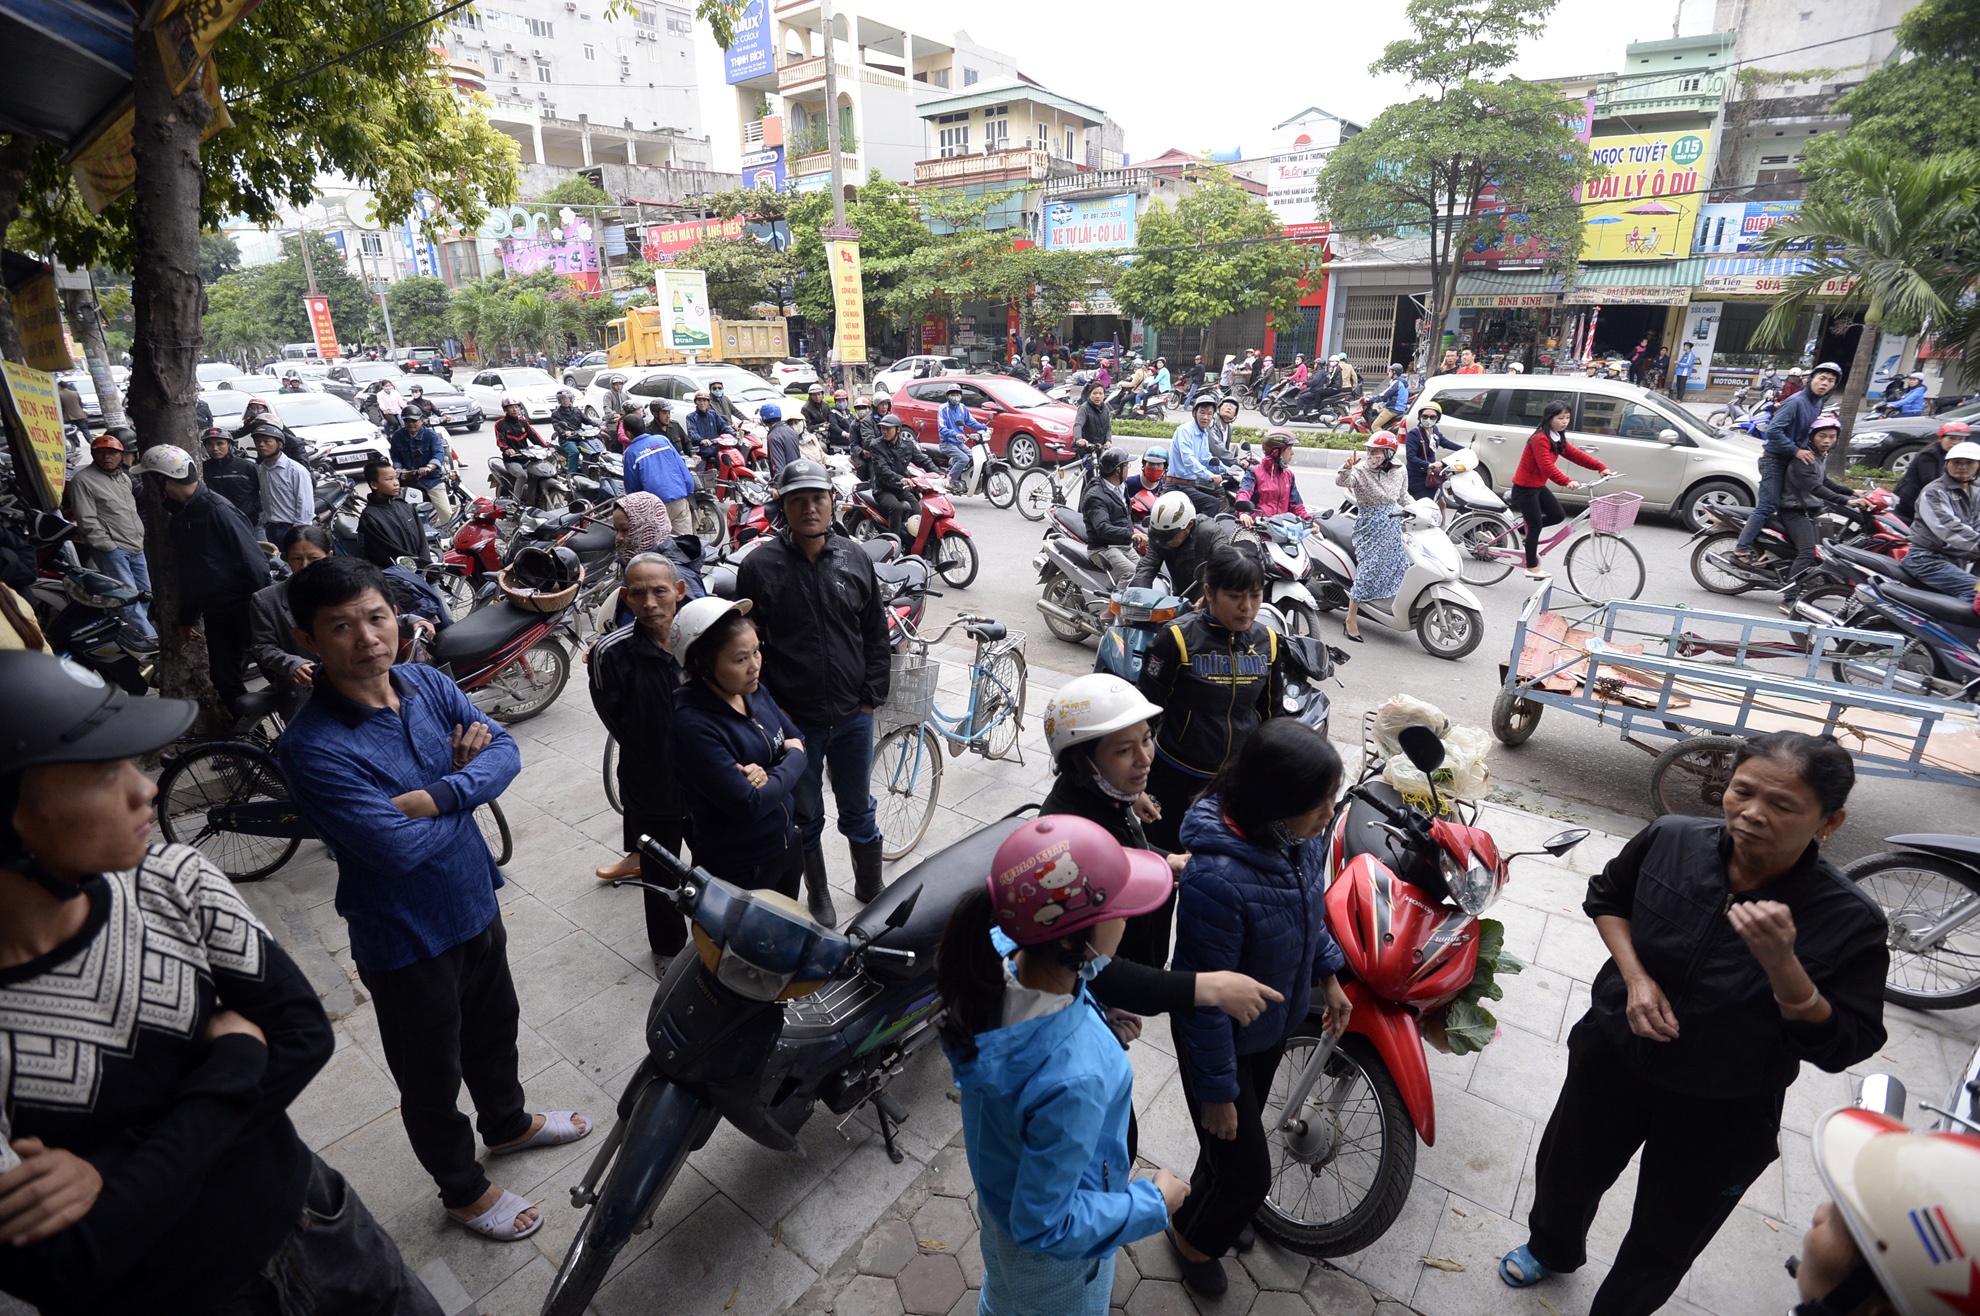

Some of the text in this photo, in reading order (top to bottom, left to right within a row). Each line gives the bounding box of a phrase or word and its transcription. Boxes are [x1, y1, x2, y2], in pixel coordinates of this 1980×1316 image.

[740, 31, 759, 43] colour
[750, 50, 765, 62] BÍCH
[1629, 139, 1668, 163] TUYẾT
[1676, 139, 1700, 154] 115
[1624, 169, 1648, 197] LÝ
[1651, 168, 1665, 196] Ô
[1669, 166, 1698, 195] DÙ
[661, 230, 677, 245] ĐIỆN
[679, 227, 694, 241] MÁY
[696, 225, 722, 240] QANG
[1053, 227, 1064, 245] XE
[1066, 226, 1077, 247] TỰ
[1078, 223, 1092, 243] LÁI
[1098, 221, 1110, 242] CÓ
[1112, 220, 1127, 241] LÁI
[1456, 295, 1475, 307] ĐIỆN
[1477, 294, 1494, 306] MÁY
[1521, 296, 1542, 306] SINH
[1647, 288, 1660, 296] KIM
[1662, 288, 1685, 297] TRANG
[1713, 378, 1749, 386] MOTOROLA
[18, 396, 39, 418] BÚN
[27, 420, 52, 444] MIẾN
[1284, 701, 1298, 711] 343
[1000, 839, 1070, 885] HELLO KITTY
[1404, 894, 1435, 915] HONDA
[694, 974, 718, 1007] HONDA
